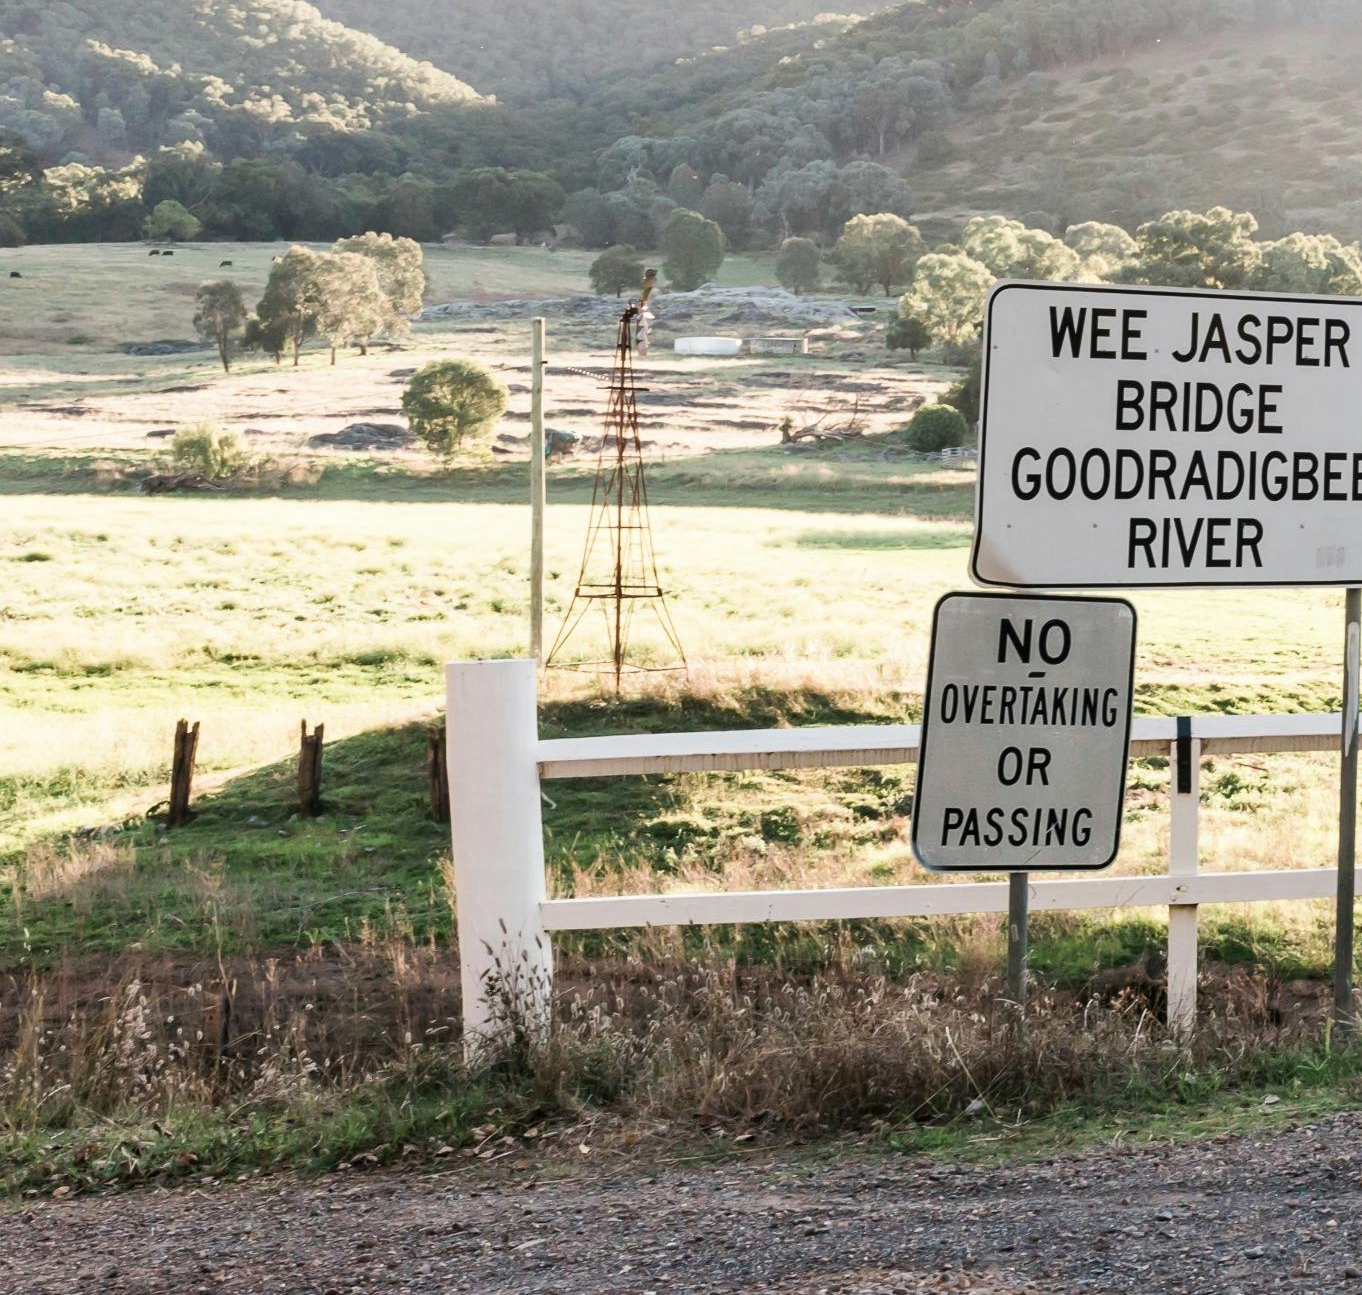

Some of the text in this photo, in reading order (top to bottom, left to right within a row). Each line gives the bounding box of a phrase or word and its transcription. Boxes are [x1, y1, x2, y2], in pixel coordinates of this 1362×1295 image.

[1049, 305, 1351, 368] WEE JASPER
[1115, 379, 1283, 435] BRIDGE
[1127, 517, 1264, 569] RIVER
[997, 618, 1072, 666] NO
[940, 683, 1119, 728] OVERTAKING
[997, 746, 1052, 787] OR
[940, 807, 1093, 847] PASSING
